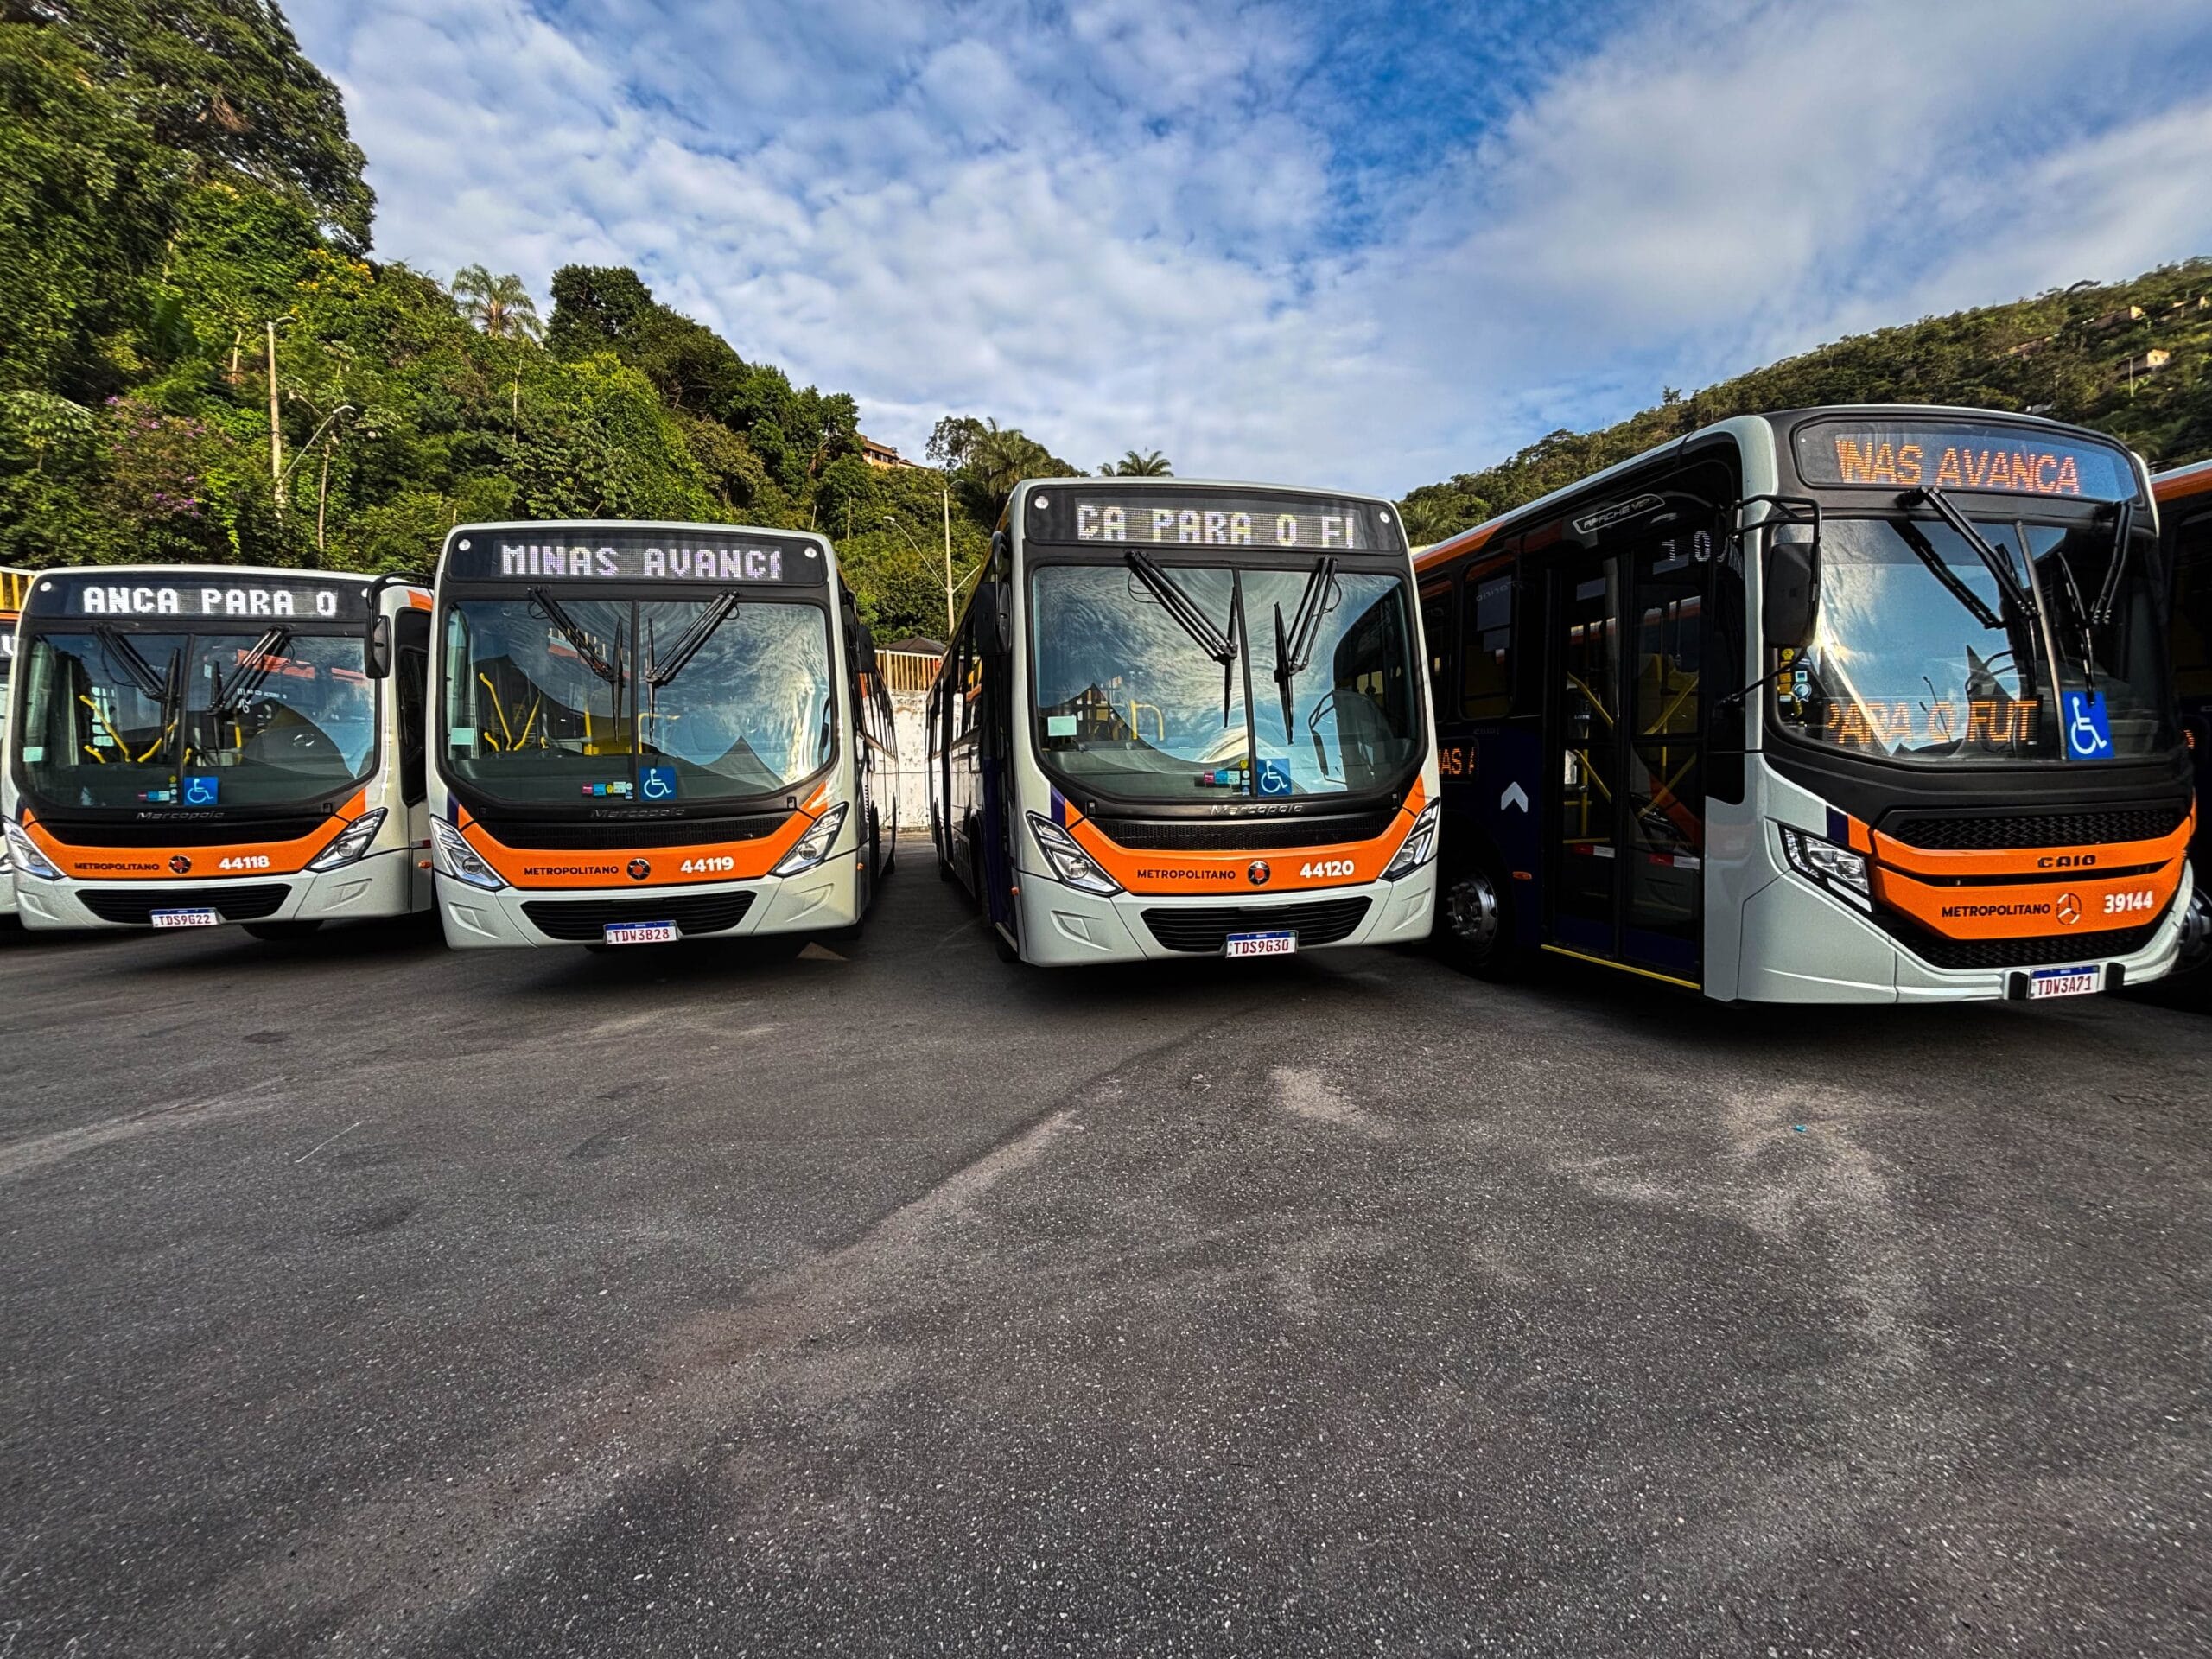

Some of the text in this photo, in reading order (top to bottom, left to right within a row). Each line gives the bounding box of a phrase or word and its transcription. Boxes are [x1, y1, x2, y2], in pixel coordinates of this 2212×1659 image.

[1152, 508, 1252, 544] PARA
[502, 545, 620, 575] MINAS
[200, 588, 294, 616] PARA
[1967, 700, 2038, 742] FUT
[1210, 804, 1304, 816] Marcopolo
[74, 855, 270, 871] METROPOLITANO 44118
[524, 856, 734, 875] METROPOLITANO 44119
[1137, 860, 1355, 880] METROPOLITANO 44120
[2037, 854, 2096, 868] CAIO
[1942, 890, 2153, 918] METROPOLITANO 39144
[159, 914, 212, 925] TDS9G22
[613, 928, 670, 943] TDW3B28
[1234, 938, 1289, 955] TDS9G30
[2037, 975, 2091, 996] TDW3A71
